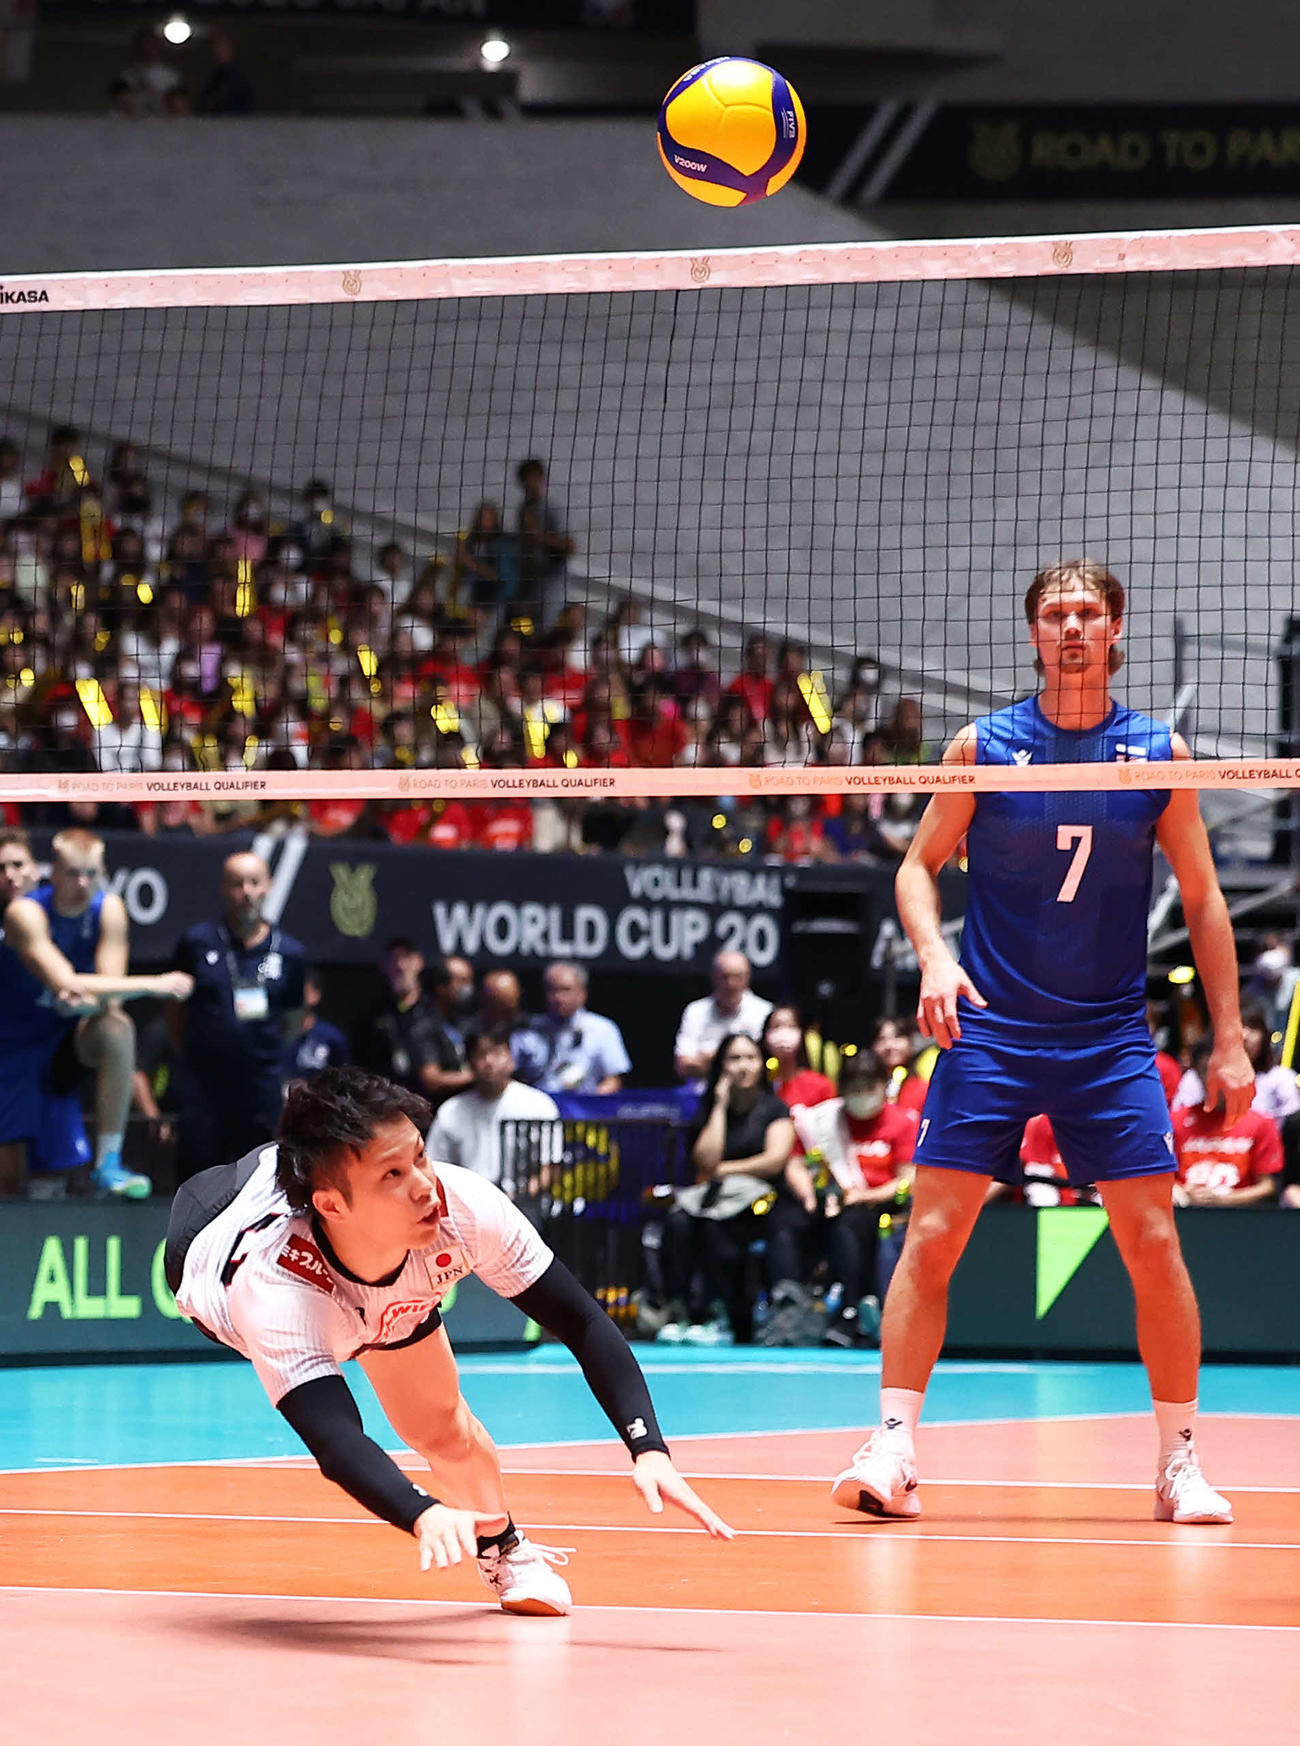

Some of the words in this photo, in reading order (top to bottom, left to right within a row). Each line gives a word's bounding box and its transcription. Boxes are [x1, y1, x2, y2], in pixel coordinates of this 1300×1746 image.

[1032, 131, 1151, 172] ROAD
[1160, 129, 1218, 171] TO
[674, 154, 708, 172] V200W
[443, 780, 458, 789] TO
[490, 779, 559, 789] VOLLEYBALL
[561, 778, 616, 788] QUALIFIER
[845, 776, 916, 785] VOLLEYBALL
[918, 775, 976, 785] QUALIFIER
[1218, 769, 1293, 780] VOLLEYBALL
[146, 781, 211, 791] VOLLEYBALL
[213, 781, 267, 790] QUALIFIER
[1056, 825, 1093, 902] 7
[432, 901, 609, 959] WORLD
[614, 906, 710, 961] CUP
[27, 1235, 142, 1320] ALL
[437, 1266, 462, 1284] JPN
